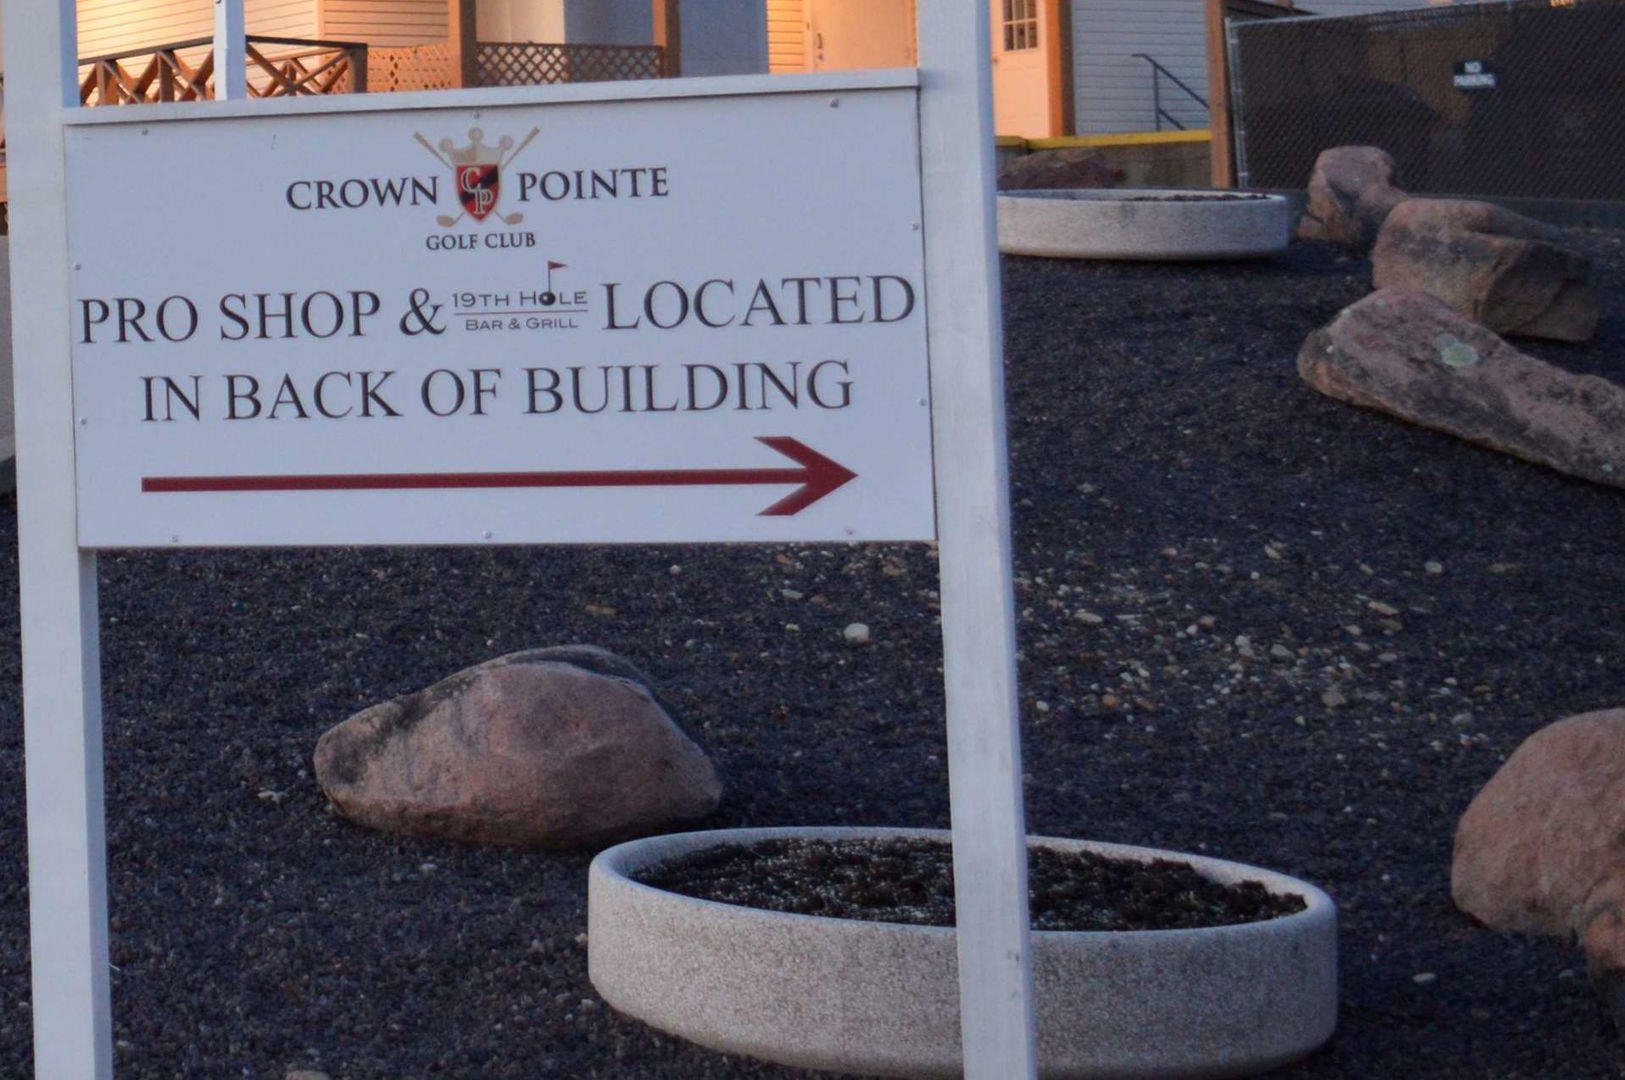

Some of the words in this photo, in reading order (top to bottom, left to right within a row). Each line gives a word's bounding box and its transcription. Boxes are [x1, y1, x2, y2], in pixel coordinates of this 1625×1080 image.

[285, 176, 439, 210] CROWN
[516, 166, 669, 202] POINTE
[425, 234, 478, 251] GOLF
[484, 232, 536, 249] CLUB
[79, 295, 199, 344] PRO
[219, 290, 381, 341] SHOP
[399, 287, 447, 336] &
[452, 292, 510, 308] 19TH
[519, 290, 588, 307] HOLE
[602, 275, 916, 331] LOCATED
[465, 319, 503, 331] BAR
[508, 318, 521, 330] &
[525, 316, 579, 330] GRILL
[141, 375, 202, 422] IN
[225, 370, 402, 420] BACK
[420, 368, 502, 416] OF
[524, 360, 854, 415] BUILDING
